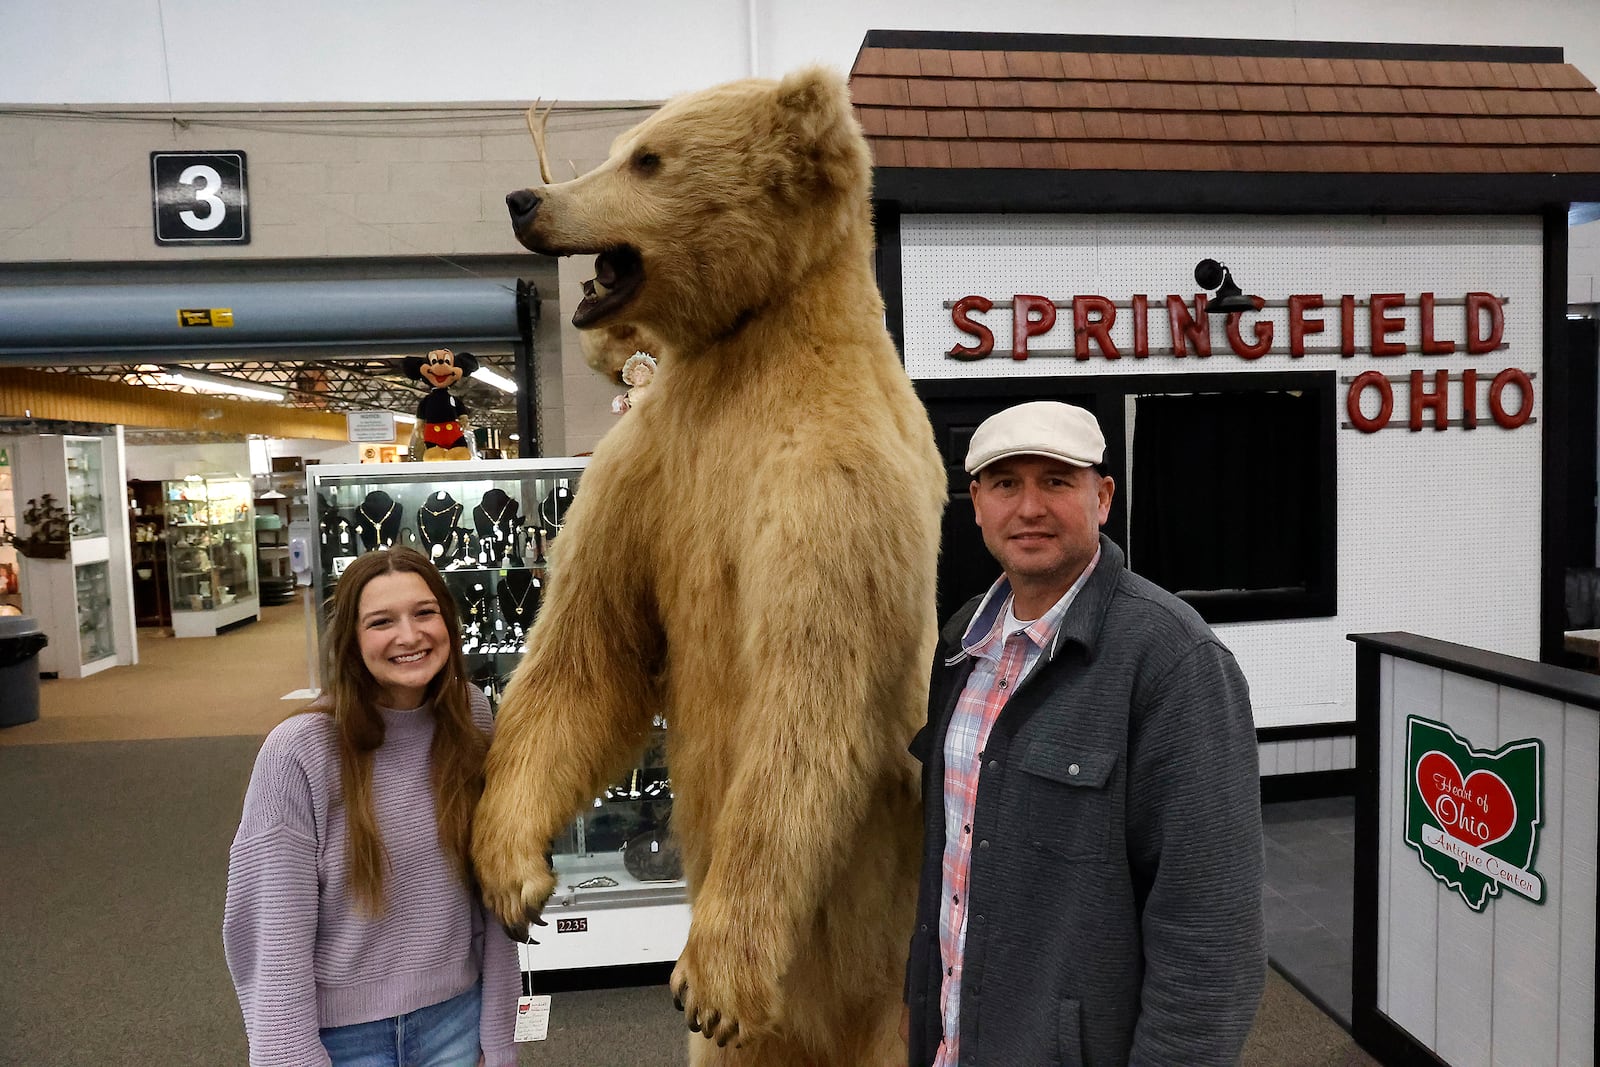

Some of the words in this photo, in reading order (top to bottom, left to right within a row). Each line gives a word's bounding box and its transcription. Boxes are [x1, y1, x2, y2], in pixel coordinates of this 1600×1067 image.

[179, 165, 226, 231] 3
[950, 292, 1505, 361] SPRINGFIELD
[1347, 367, 1534, 433] OHIO
[1432, 773, 1473, 802] Heart
[1476, 794, 1489, 814] of
[1435, 794, 1490, 840] Ohio
[1427, 834, 1483, 867] Antique
[1486, 856, 1534, 893] Center
[558, 919, 587, 932] 2235
